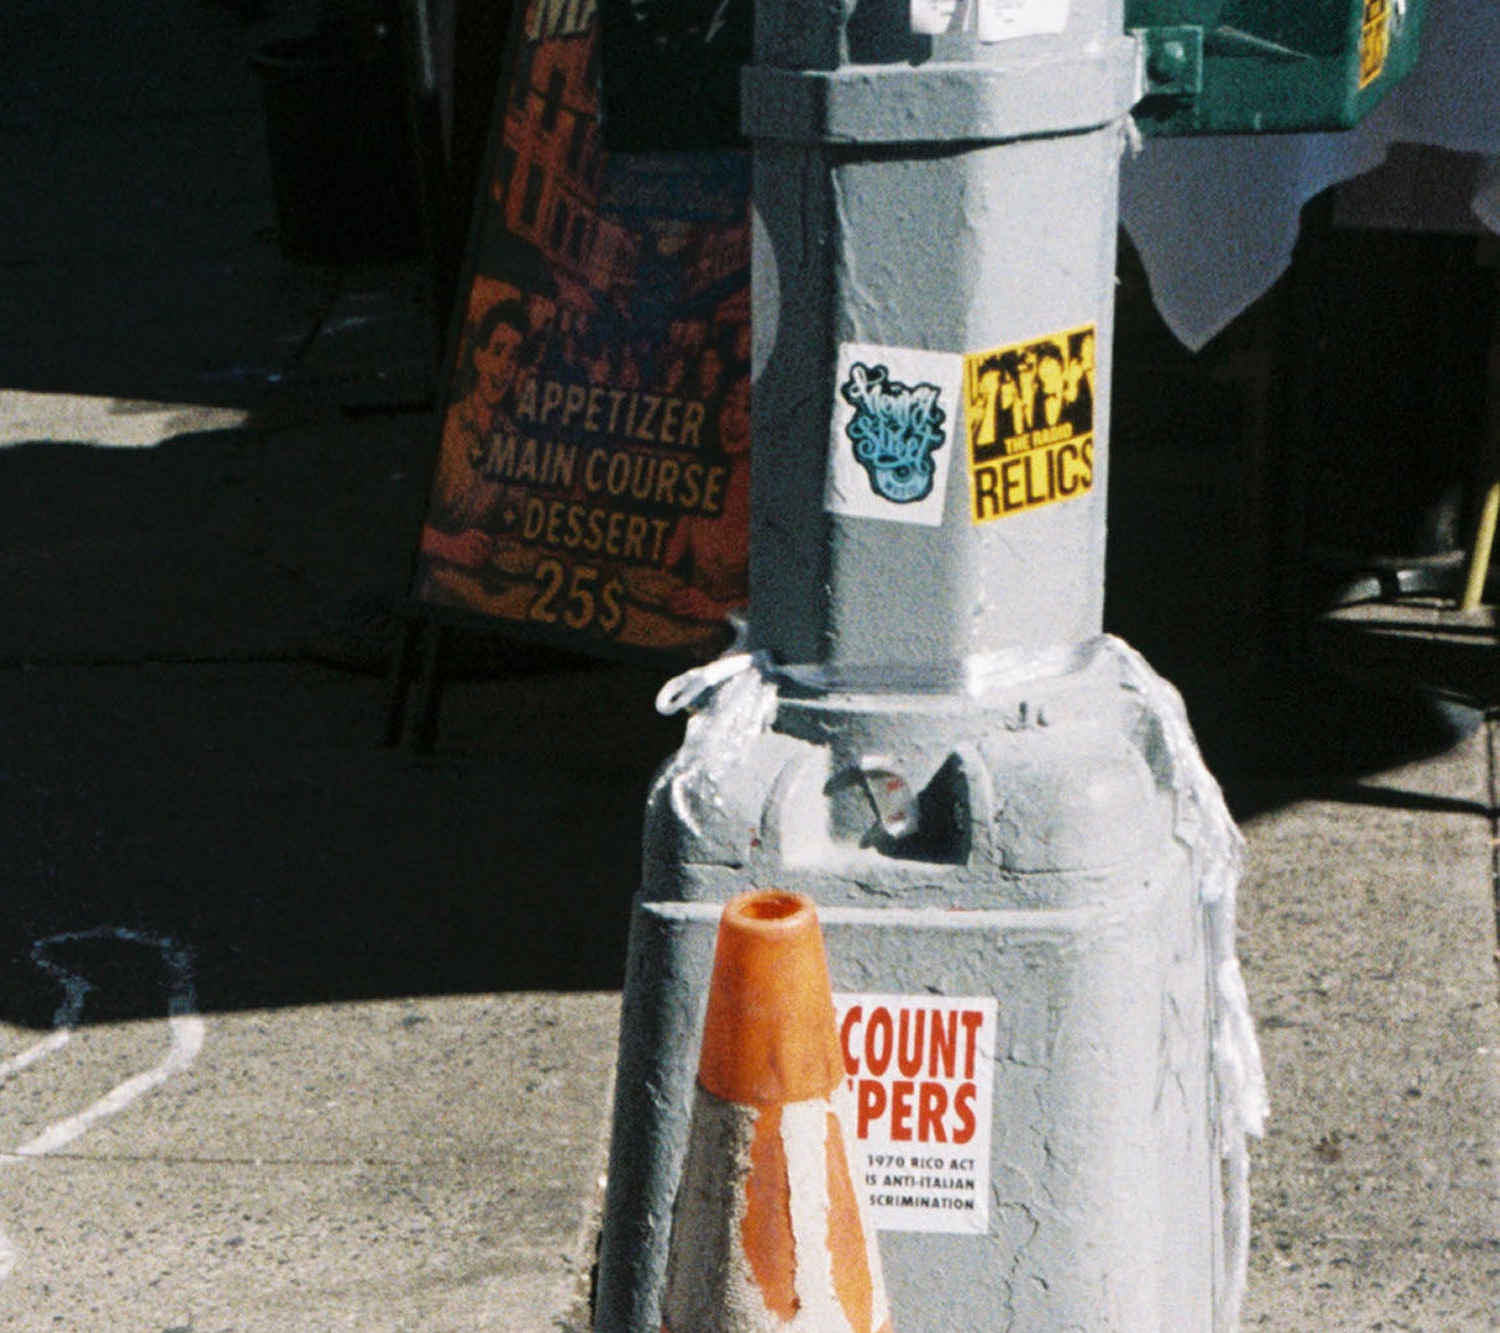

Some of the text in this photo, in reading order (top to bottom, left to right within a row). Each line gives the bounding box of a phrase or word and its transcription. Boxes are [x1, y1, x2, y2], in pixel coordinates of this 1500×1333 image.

[515, 380, 706, 448] APPETIZER
[484, 432, 578, 487] MAIN
[585, 448, 727, 513] COURSE
[974, 437, 1093, 519] RELICS
[522, 497, 670, 562] DESSERT
[528, 559, 627, 632] 25$
[840, 1006, 984, 1080] COUNT
[847, 1078, 977, 1145] PERS
[867, 1154, 975, 1171] 1970 RICO ACT
[883, 1175, 975, 1191] ANTI-ITALIAN
[869, 1194, 975, 1211] SCRIMINATION
